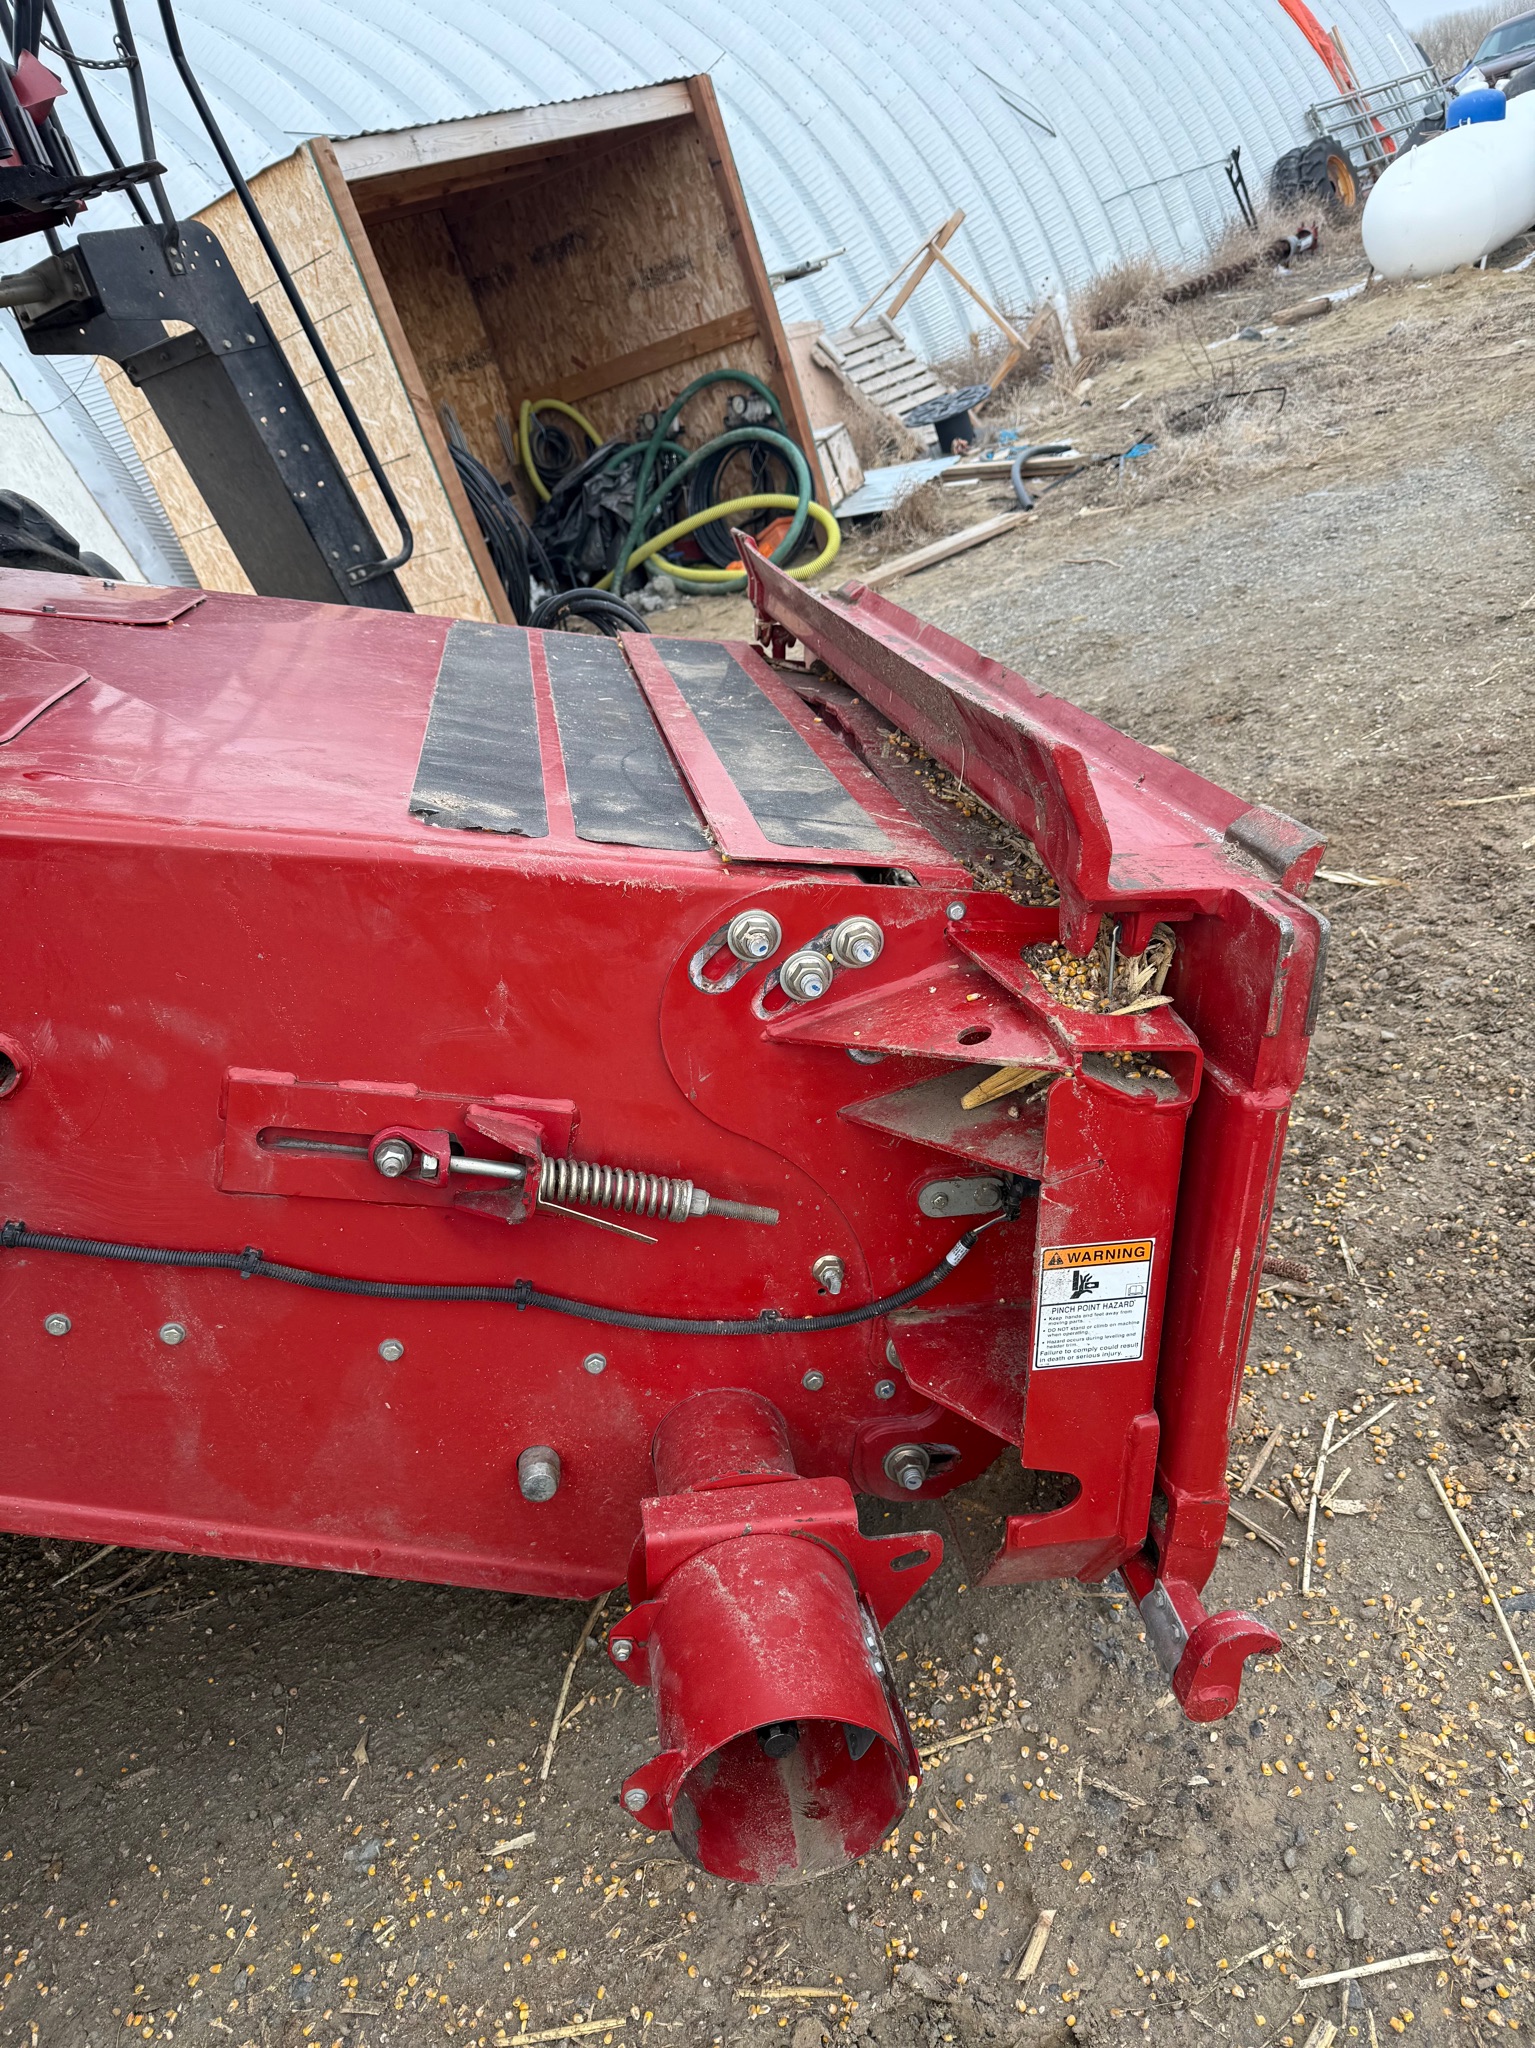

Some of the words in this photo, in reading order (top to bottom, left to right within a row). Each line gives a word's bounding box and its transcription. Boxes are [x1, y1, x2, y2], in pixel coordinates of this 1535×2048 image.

[1067, 1246, 1145, 1263] WARNING
[1052, 1306, 1075, 1314] PINCH
[1078, 1304, 1100, 1312] POINT
[1103, 1300, 1134, 1309] HAZARD
